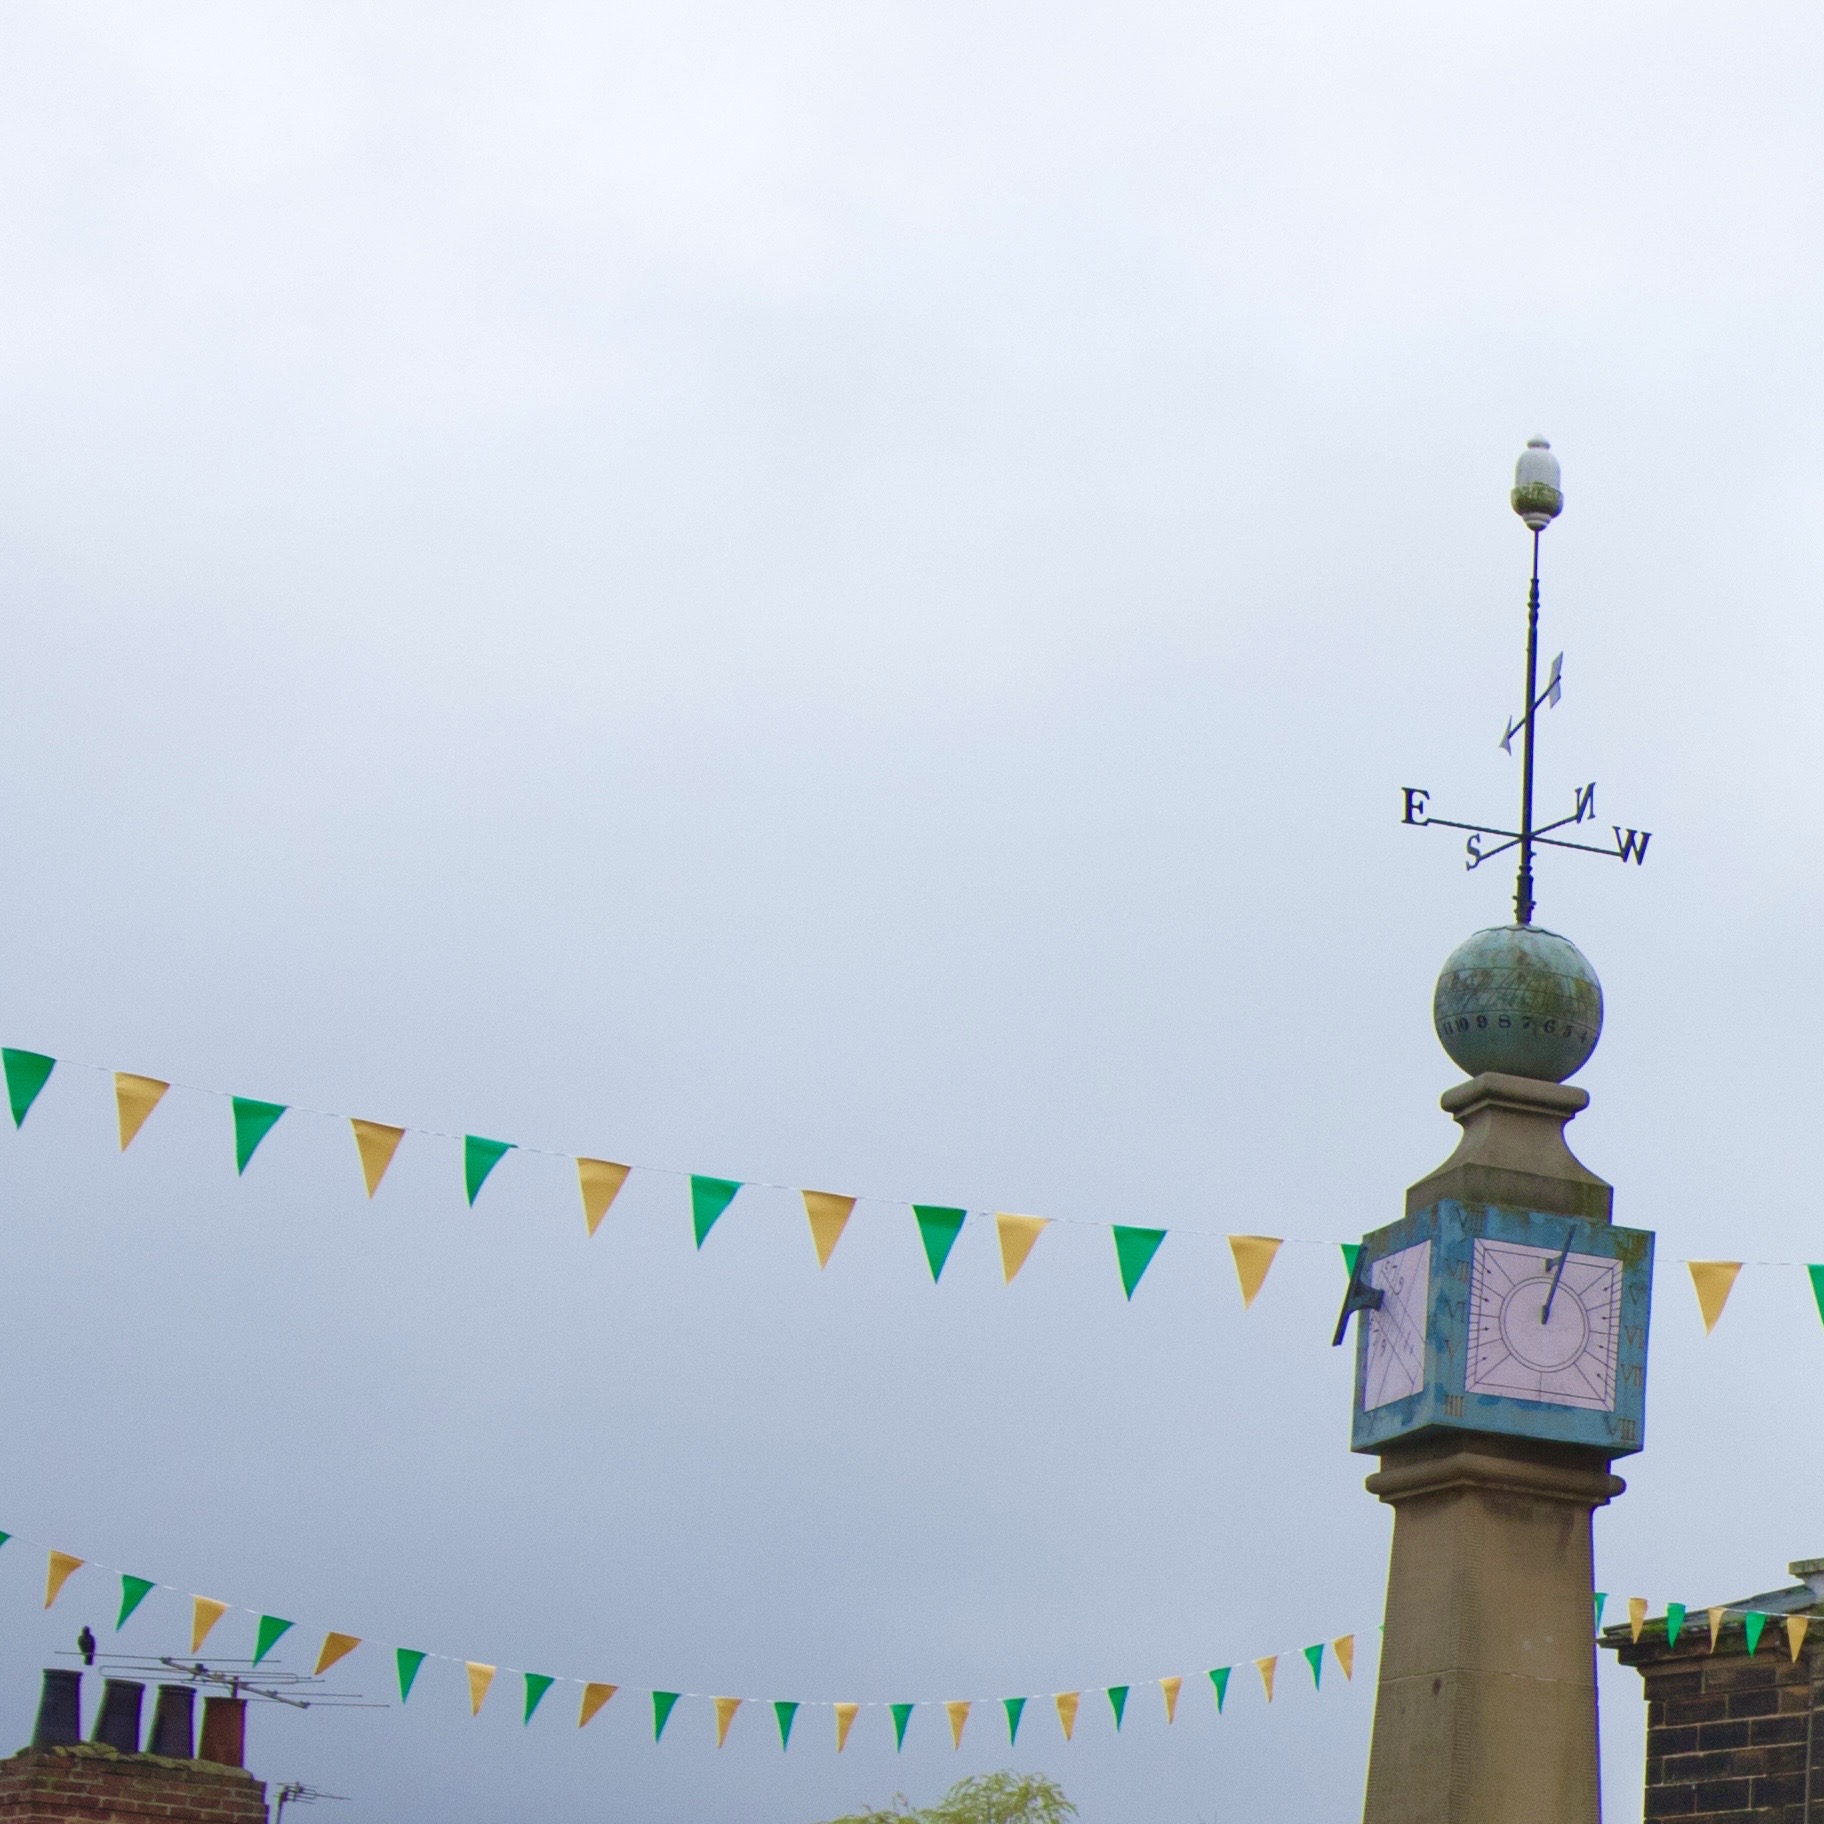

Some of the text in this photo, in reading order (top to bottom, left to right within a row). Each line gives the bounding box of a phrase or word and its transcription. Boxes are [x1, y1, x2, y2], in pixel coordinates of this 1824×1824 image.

[1401, 787, 1430, 826] E
[1612, 826, 1652, 866] W
[1499, 1014, 1512, 1028] 8
